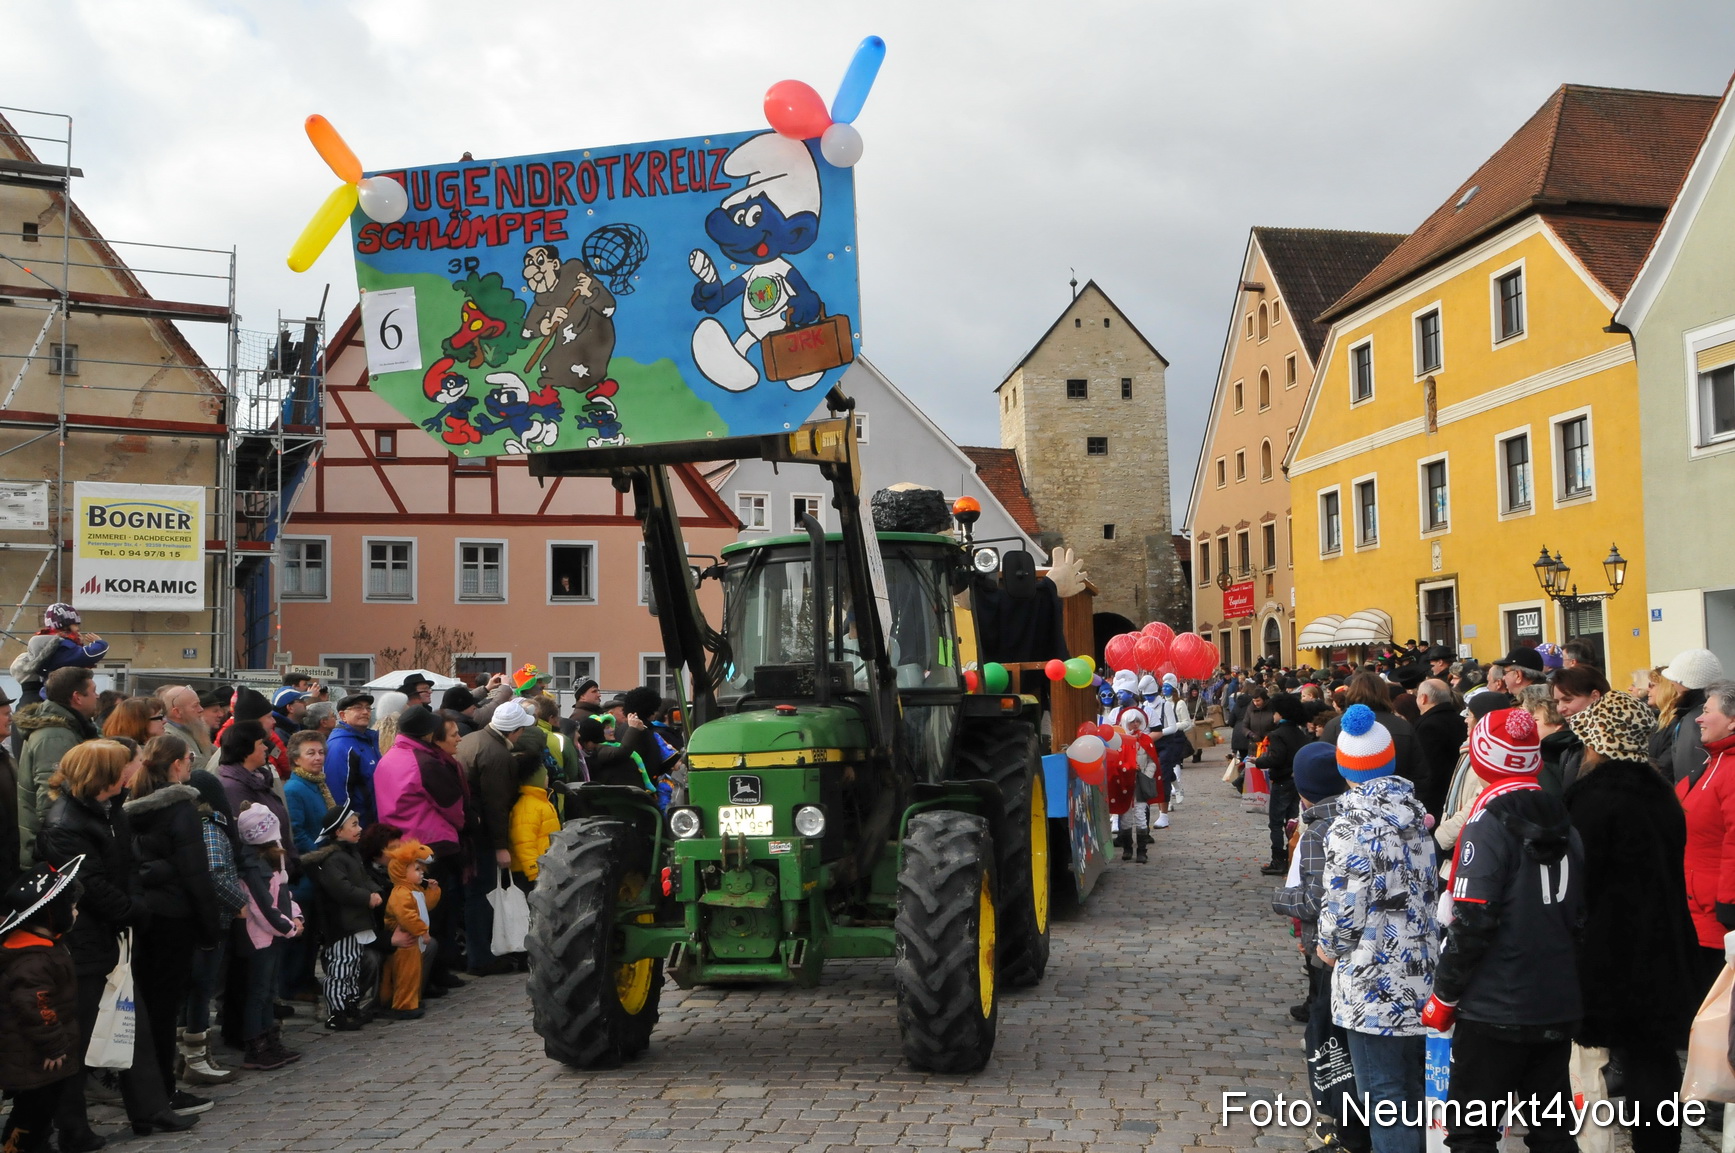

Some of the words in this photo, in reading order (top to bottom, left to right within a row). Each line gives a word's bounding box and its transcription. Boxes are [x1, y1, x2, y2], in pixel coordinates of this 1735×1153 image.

[357, 208, 570, 255] SCHLÜMPFE
[447, 256, 480, 274] 3D
[380, 308, 403, 350] 6
[785, 327, 825, 352] JRK
[87, 533, 127, 541] ZIMMEREI
[133, 534, 192, 543] DACHDECKEREI
[128, 549, 141, 557] 94
[104, 578, 197, 595] KORAMIC
[1518, 613, 1537, 626] BW
[735, 808, 755, 819] NM
